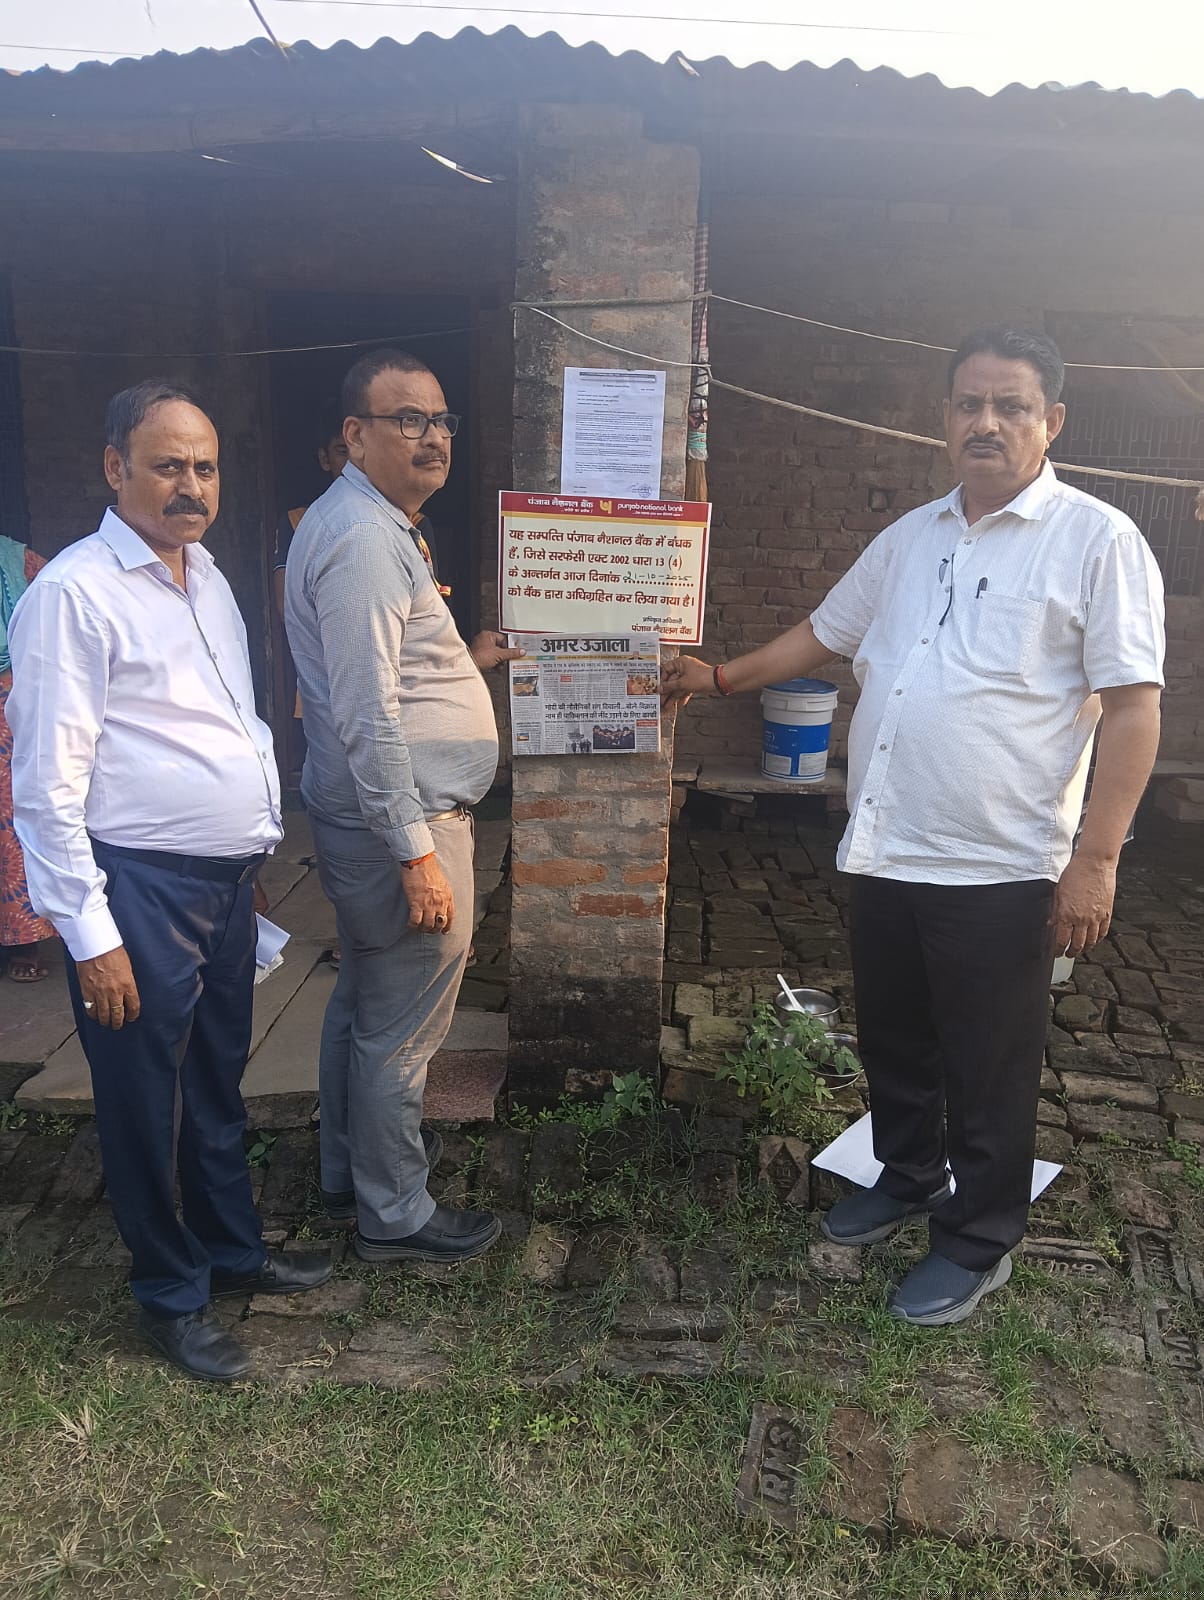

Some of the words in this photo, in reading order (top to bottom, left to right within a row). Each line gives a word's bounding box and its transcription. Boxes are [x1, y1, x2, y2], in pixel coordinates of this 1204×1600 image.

[617, 503, 640, 511] punjab
[509, 529, 524, 540] यह
[527, 528, 563, 541] सम्पत्ति
[597, 531, 633, 546] नैशनल
[655, 535, 667, 547] में
[523, 546, 546, 560] जिसे
[548, 549, 585, 562] सरफेसी
[610, 555, 629, 564] 2002
[655, 557, 665, 566] 13
[668, 554, 683, 570] (4)
[508, 565, 519, 577] के
[521, 567, 560, 580] अन्तर्गत
[562, 571, 586, 581] आज
[588, 569, 621, 583] दिनांक
[507, 585, 521, 596] को
[544, 589, 563, 599] द्वारा
[565, 588, 613, 602] अधिग्रहित
[615, 593, 632, 603] कर
[634, 591, 658, 604] लिया
[660, 595, 680, 606] गया
[540, 638, 580, 653] अमर
[579, 638, 630, 653] उजाला
